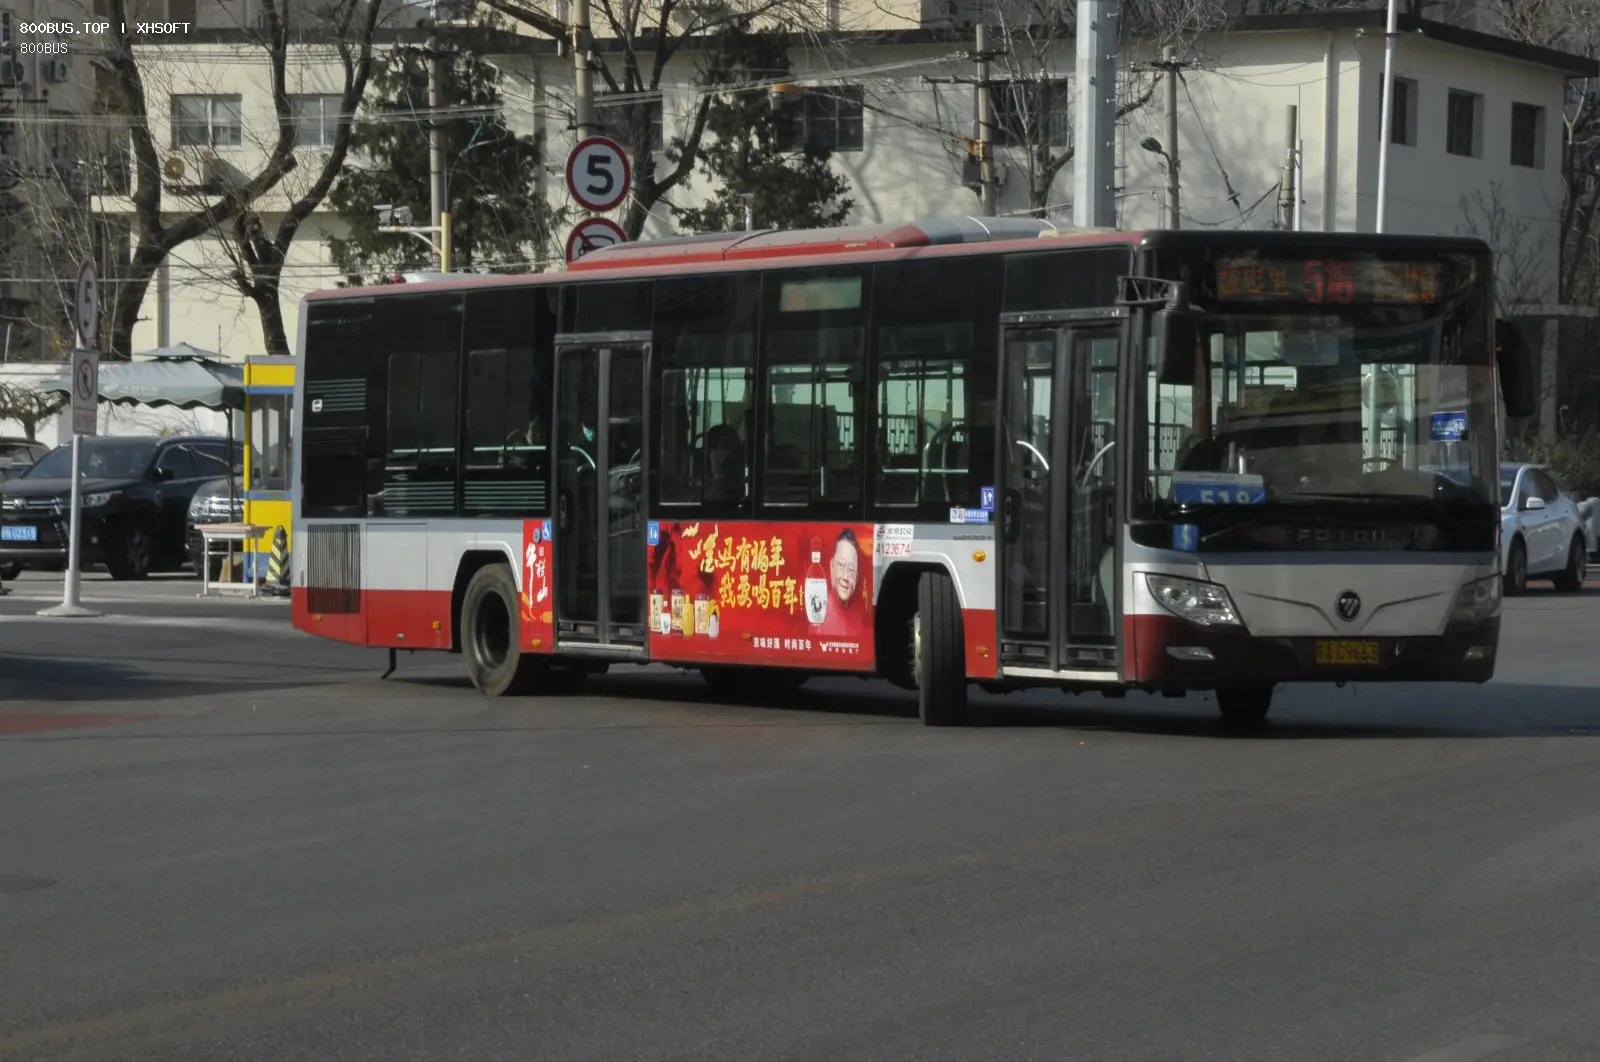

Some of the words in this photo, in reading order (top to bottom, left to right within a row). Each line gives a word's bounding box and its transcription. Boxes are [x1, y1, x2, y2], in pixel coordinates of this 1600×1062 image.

[586, 153, 614, 196] 5
[83, 280, 93, 329] 5
[875, 542, 911, 555] 4123674
